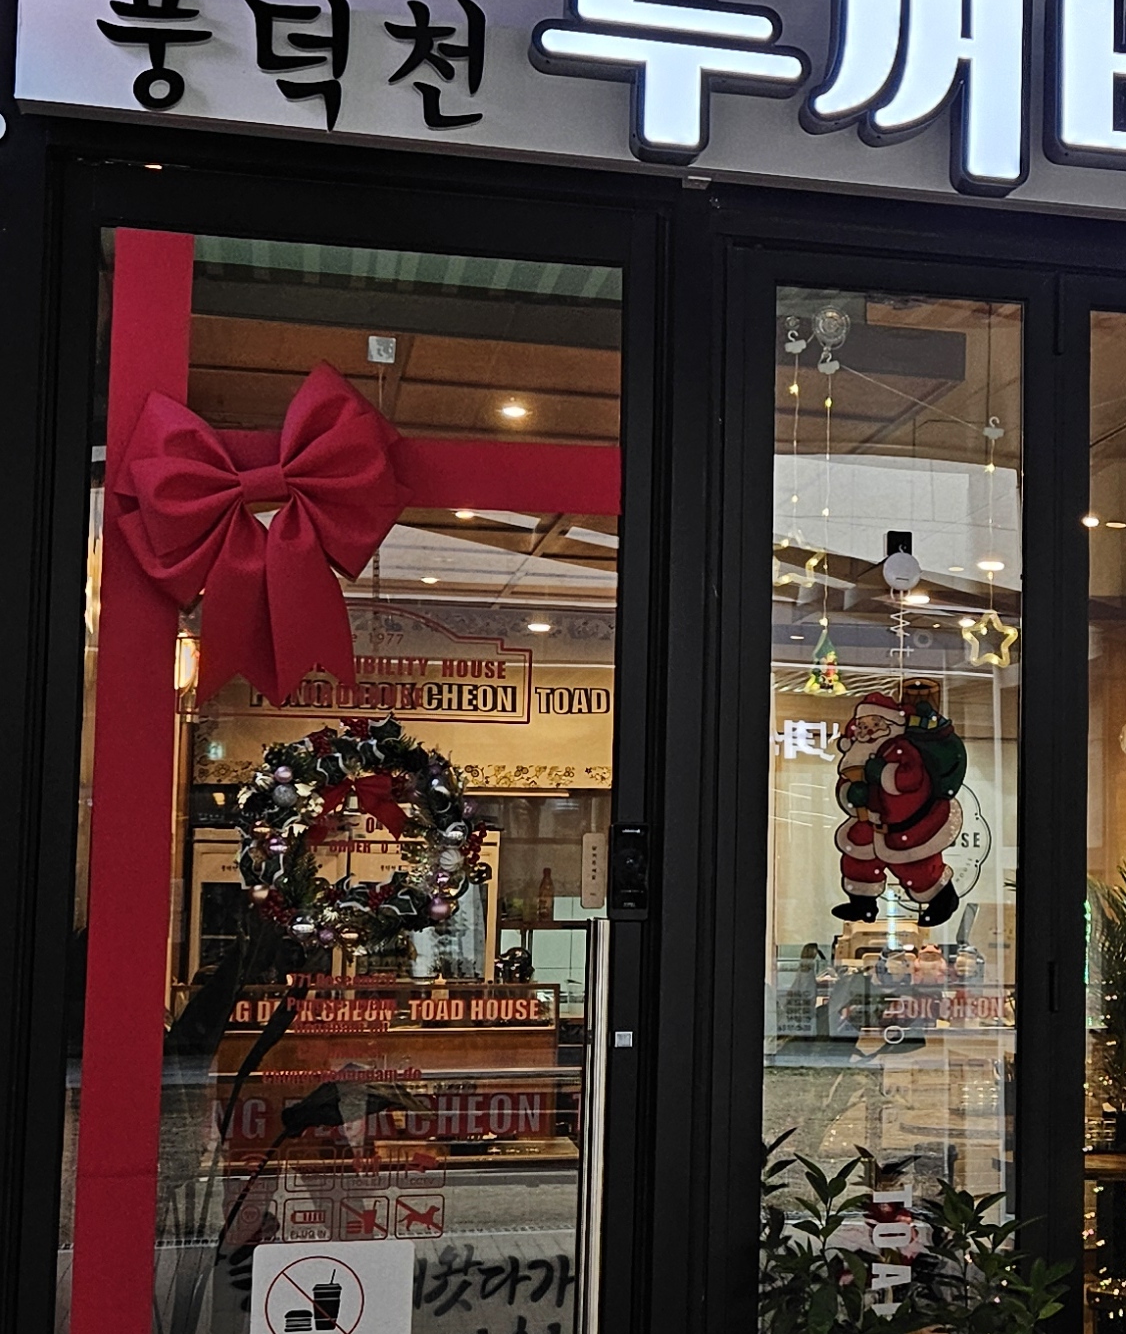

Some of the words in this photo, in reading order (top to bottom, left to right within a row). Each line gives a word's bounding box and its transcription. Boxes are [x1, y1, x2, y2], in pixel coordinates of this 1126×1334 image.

[441, 657, 507, 681] HOUSE
[421, 680, 518, 714] CHEON
[535, 686, 612, 715] TOAD
[408, 999, 464, 1021] TOAD
[470, 998, 540, 1021] HOUSE
